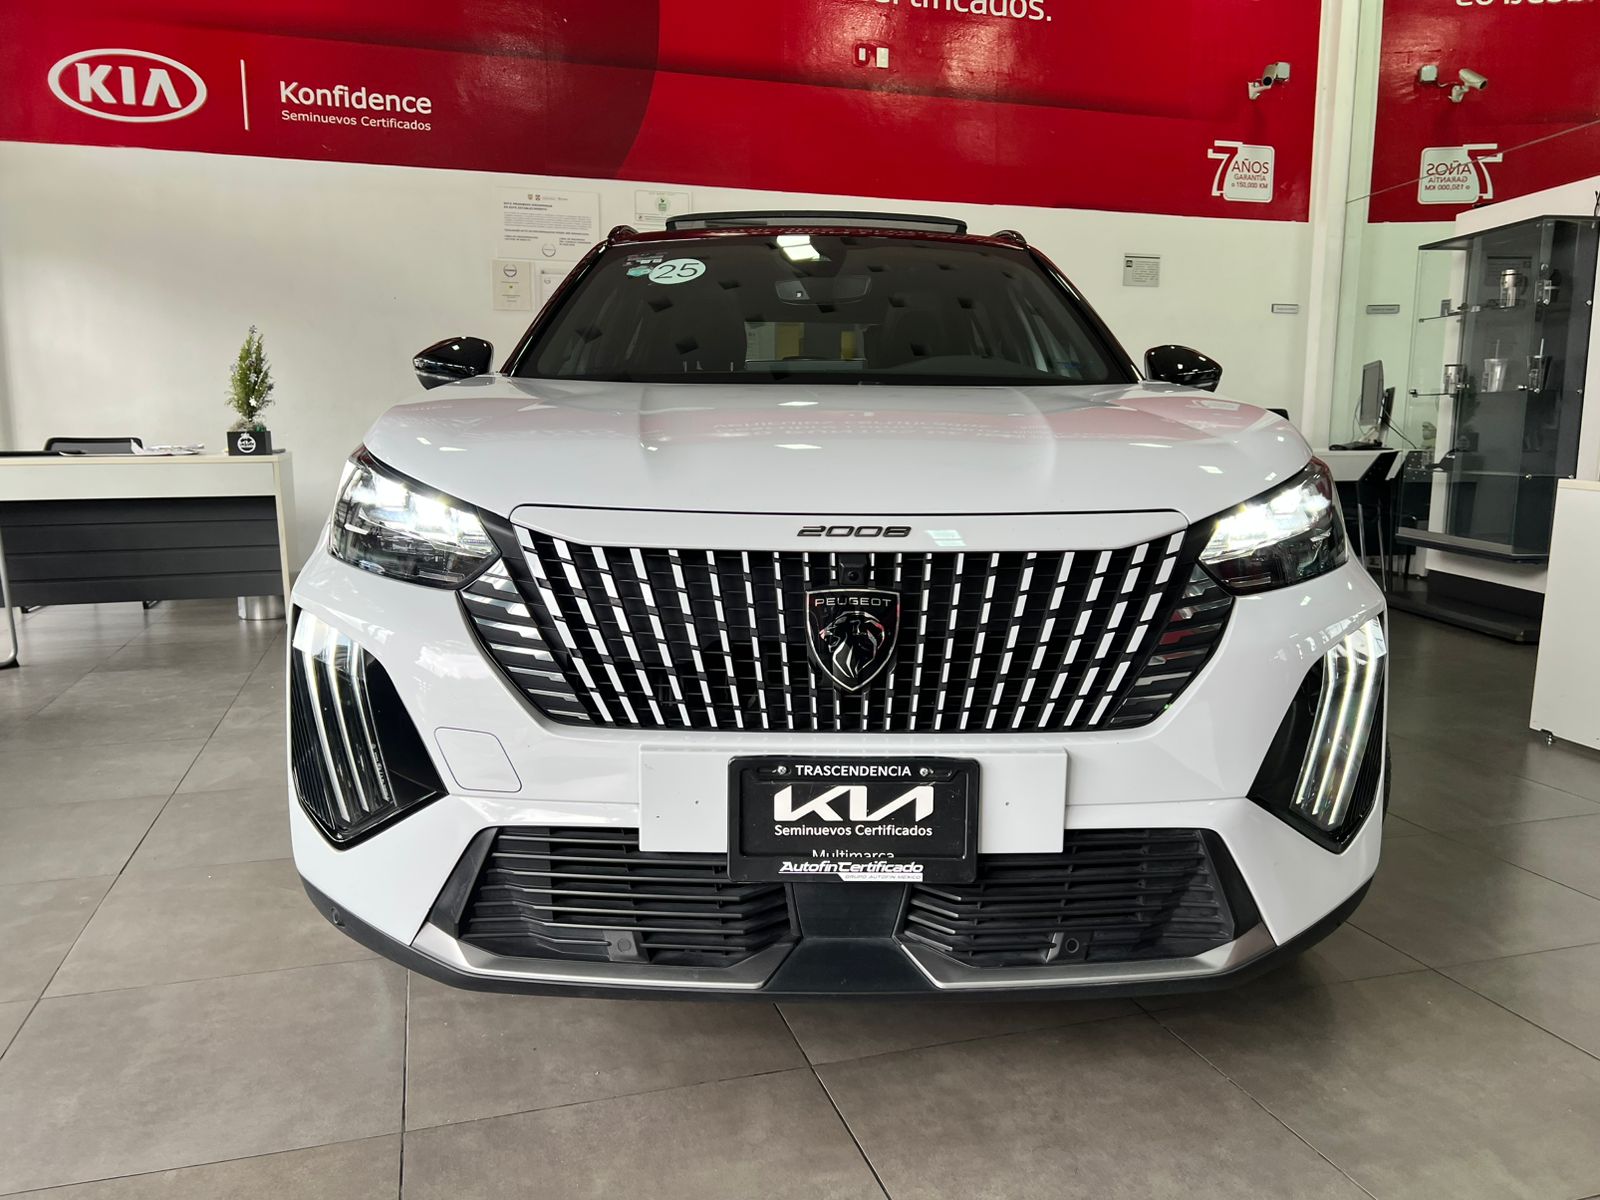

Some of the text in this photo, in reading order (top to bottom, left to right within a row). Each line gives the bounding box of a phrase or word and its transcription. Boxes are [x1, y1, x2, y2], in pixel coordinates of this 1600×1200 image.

[75, 63, 182, 108] KIA
[279, 80, 432, 114] Konfidence
[281, 110, 432, 131] Seminuevos Certificados
[1231, 158, 1270, 174] AÑOS
[654, 263, 699, 279] 25
[797, 525, 912, 538] 2008
[814, 597, 892, 607] PEUGEOT
[795, 764, 912, 777] TRASCENDENCIA
[774, 824, 933, 837] Seminuevos Certificados
